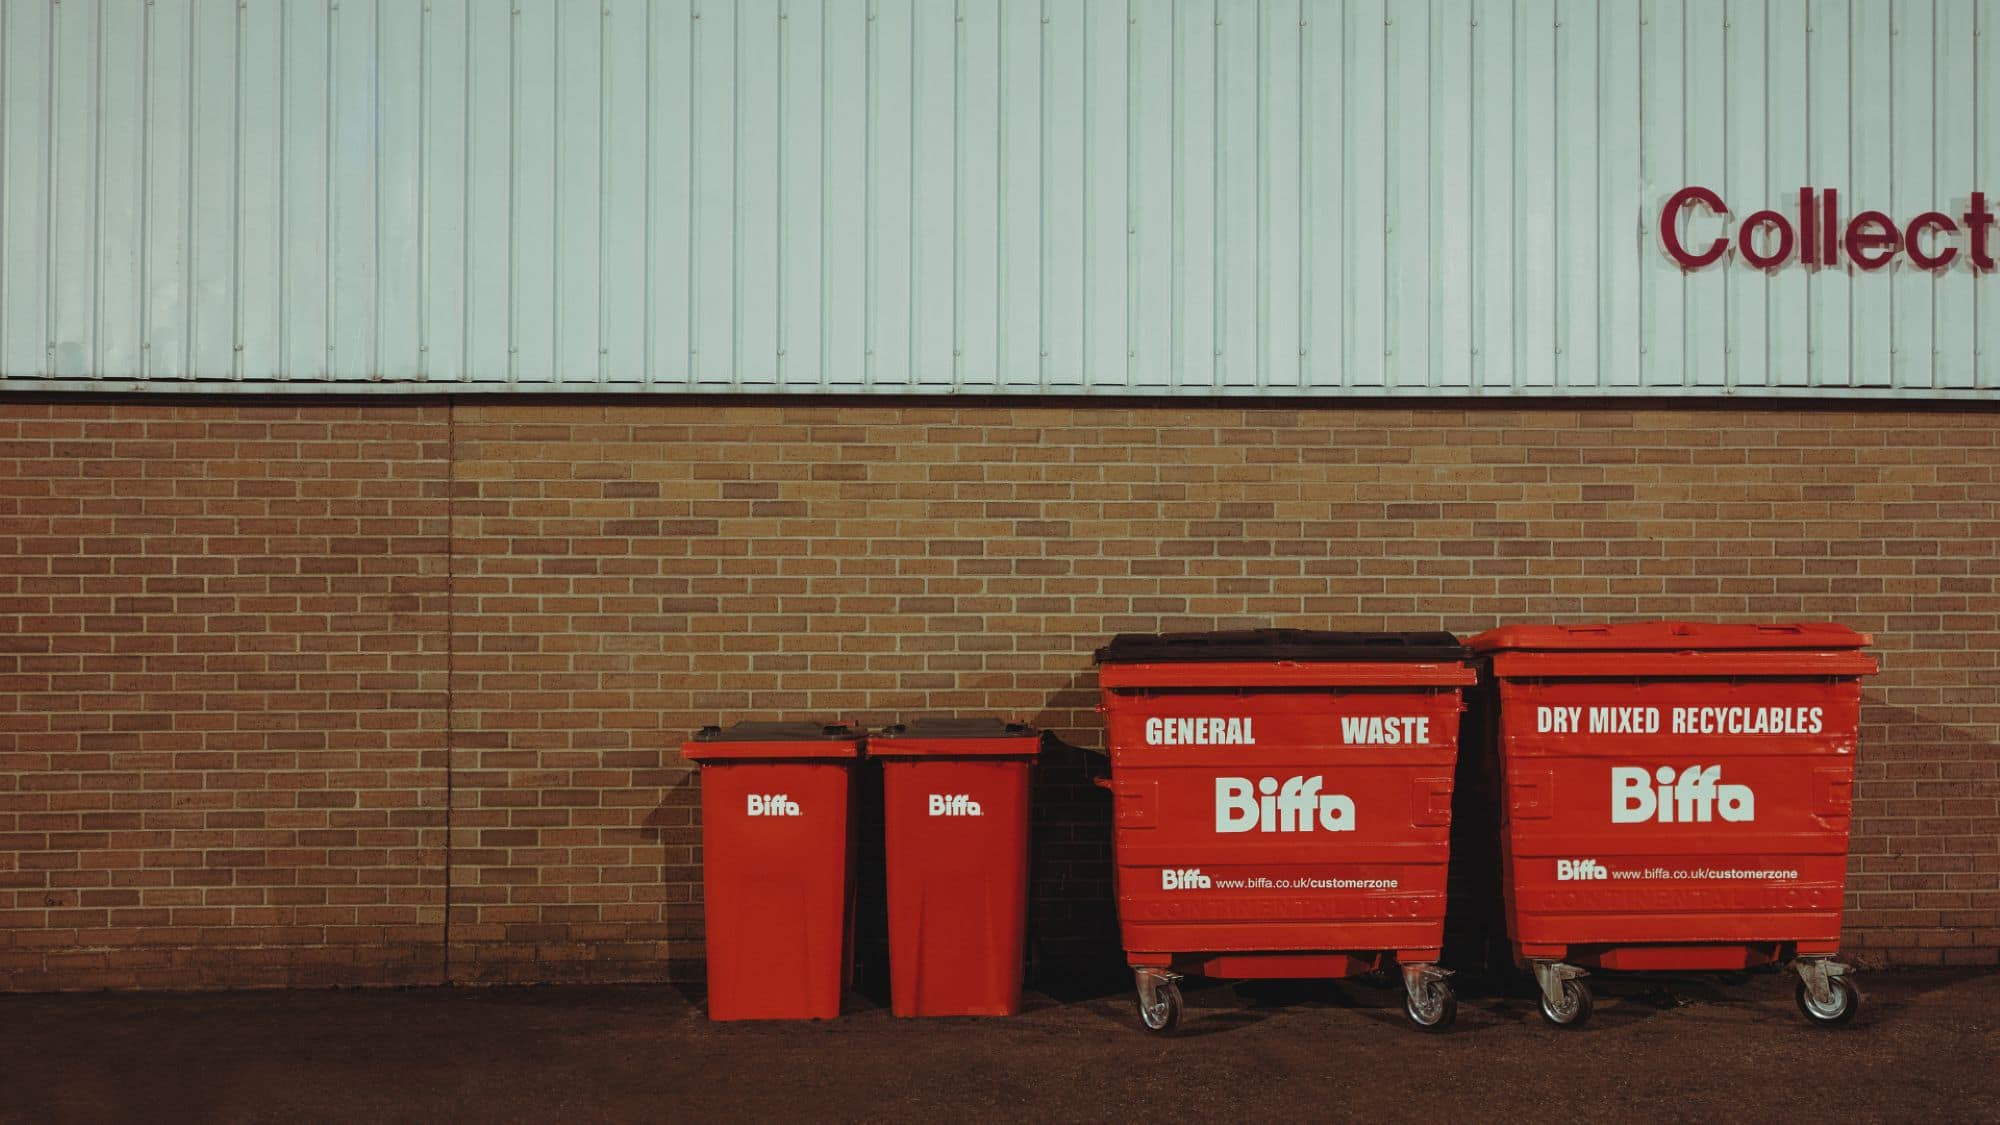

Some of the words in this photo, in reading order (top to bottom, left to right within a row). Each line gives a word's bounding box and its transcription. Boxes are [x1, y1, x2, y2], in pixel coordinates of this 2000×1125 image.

[1660, 186, 1995, 270] Collect
[1145, 716, 1256, 745] GENERAL
[1340, 716, 1430, 745] WASTE
[1537, 707, 1582, 734] DRY
[1589, 707, 1660, 734] MIXED
[1672, 706, 1823, 734] RECYCLABLES
[747, 793, 800, 817] Biffa
[928, 793, 982, 817] Biffa
[1215, 775, 1356, 833] Biffa
[1611, 764, 1755, 824] Biffa
[1161, 868, 1212, 890] Biffa
[1215, 876, 1399, 889] www.biffa.co.uk/customerzone
[1557, 859, 1608, 880] Biffa
[1612, 868, 1798, 880] www.biffa.co.uk/customerzone
